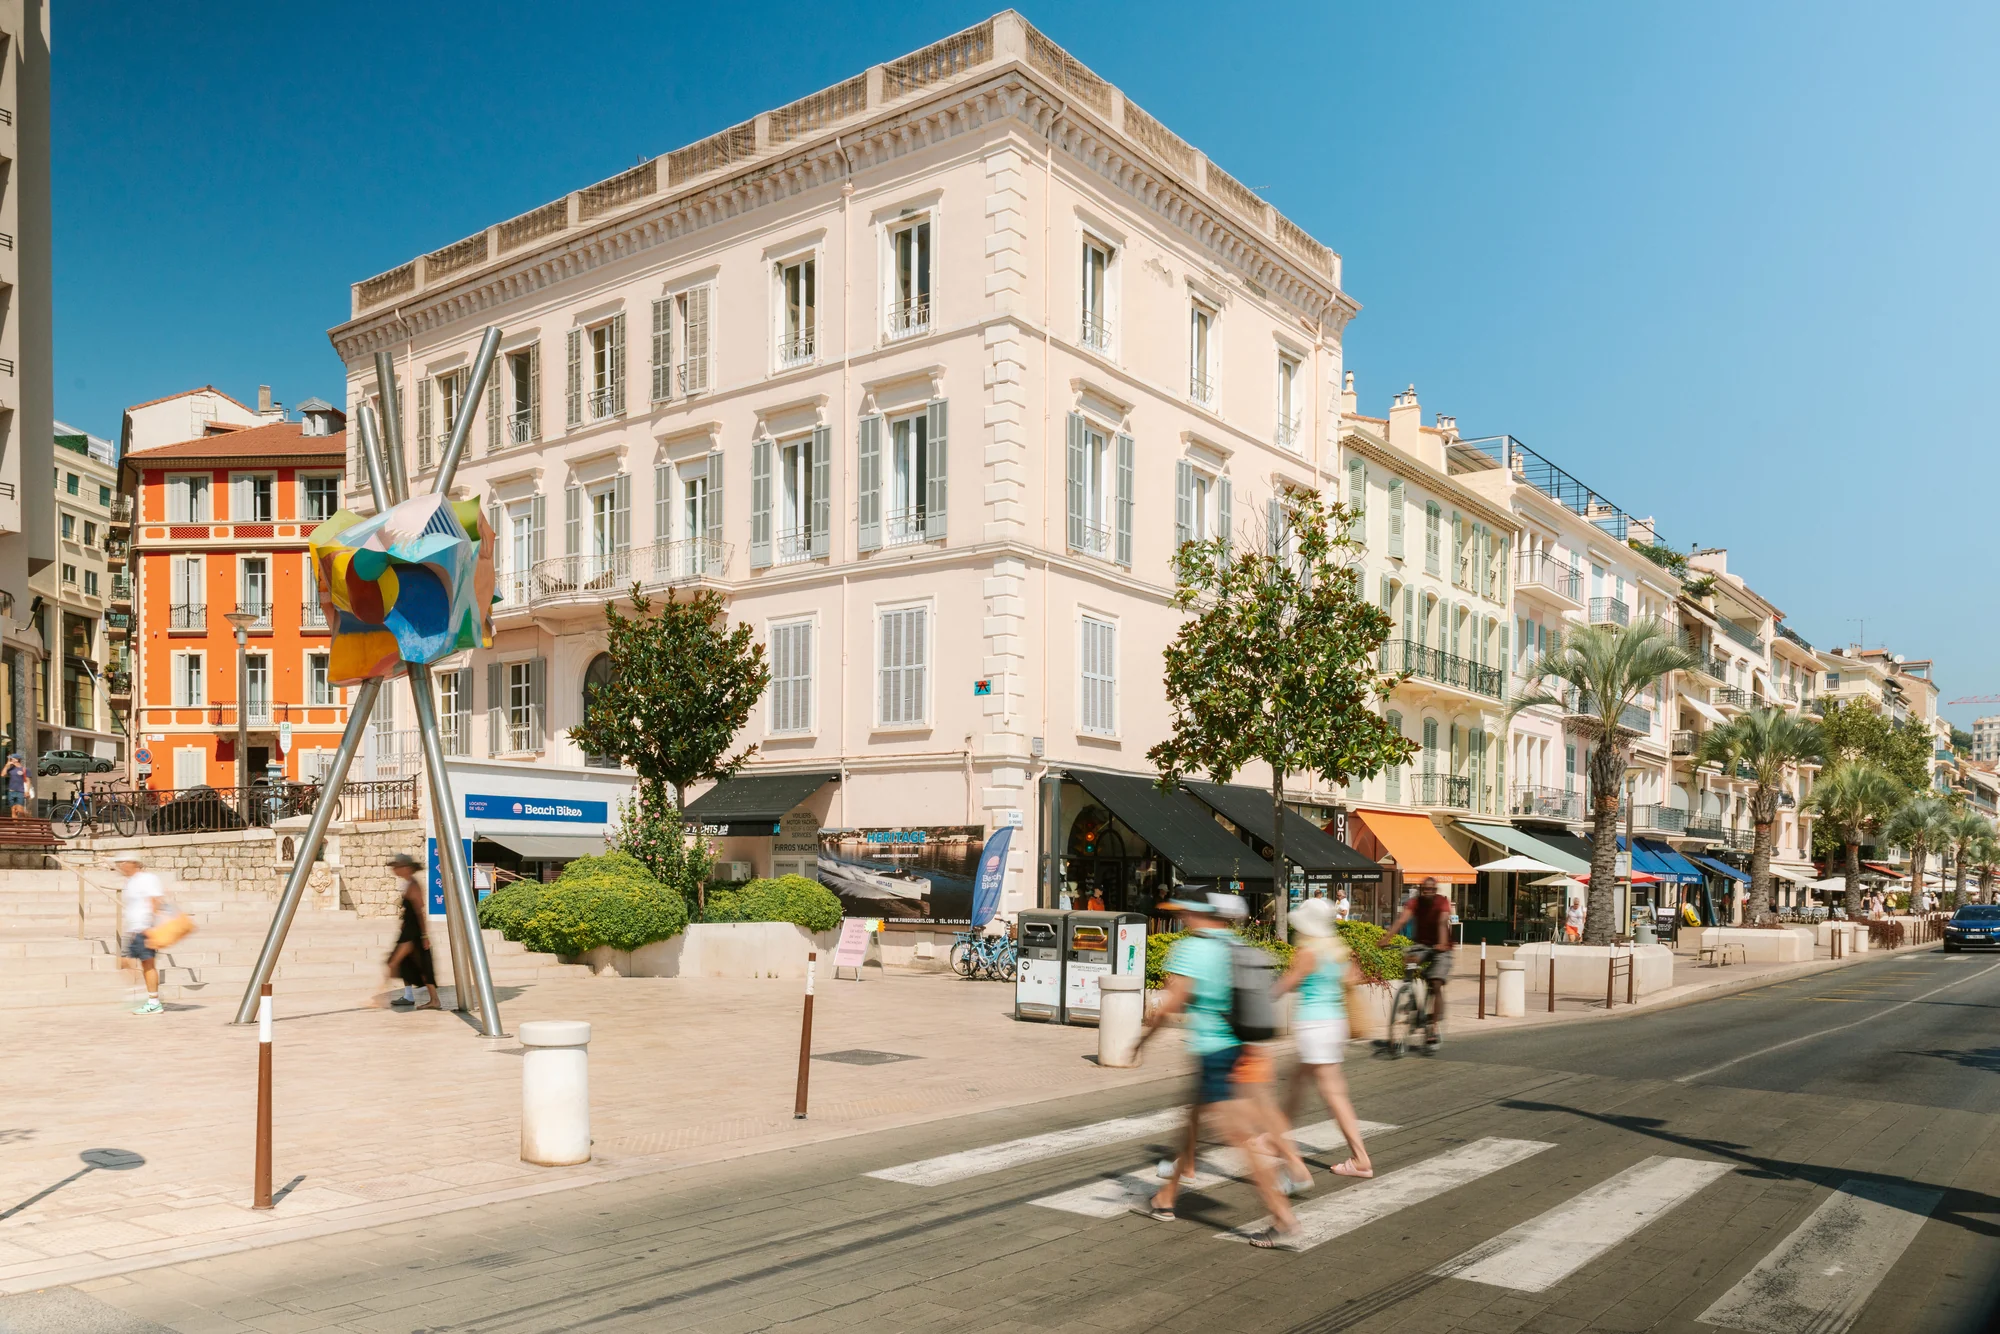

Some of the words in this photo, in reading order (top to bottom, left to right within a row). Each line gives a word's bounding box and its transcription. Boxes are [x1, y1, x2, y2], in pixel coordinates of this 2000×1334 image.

[525, 804, 555, 815] Beach
[556, 805, 582, 816] Bikes
[867, 831, 926, 844] HERITAGE
[774, 844, 796, 852] FIRROS
